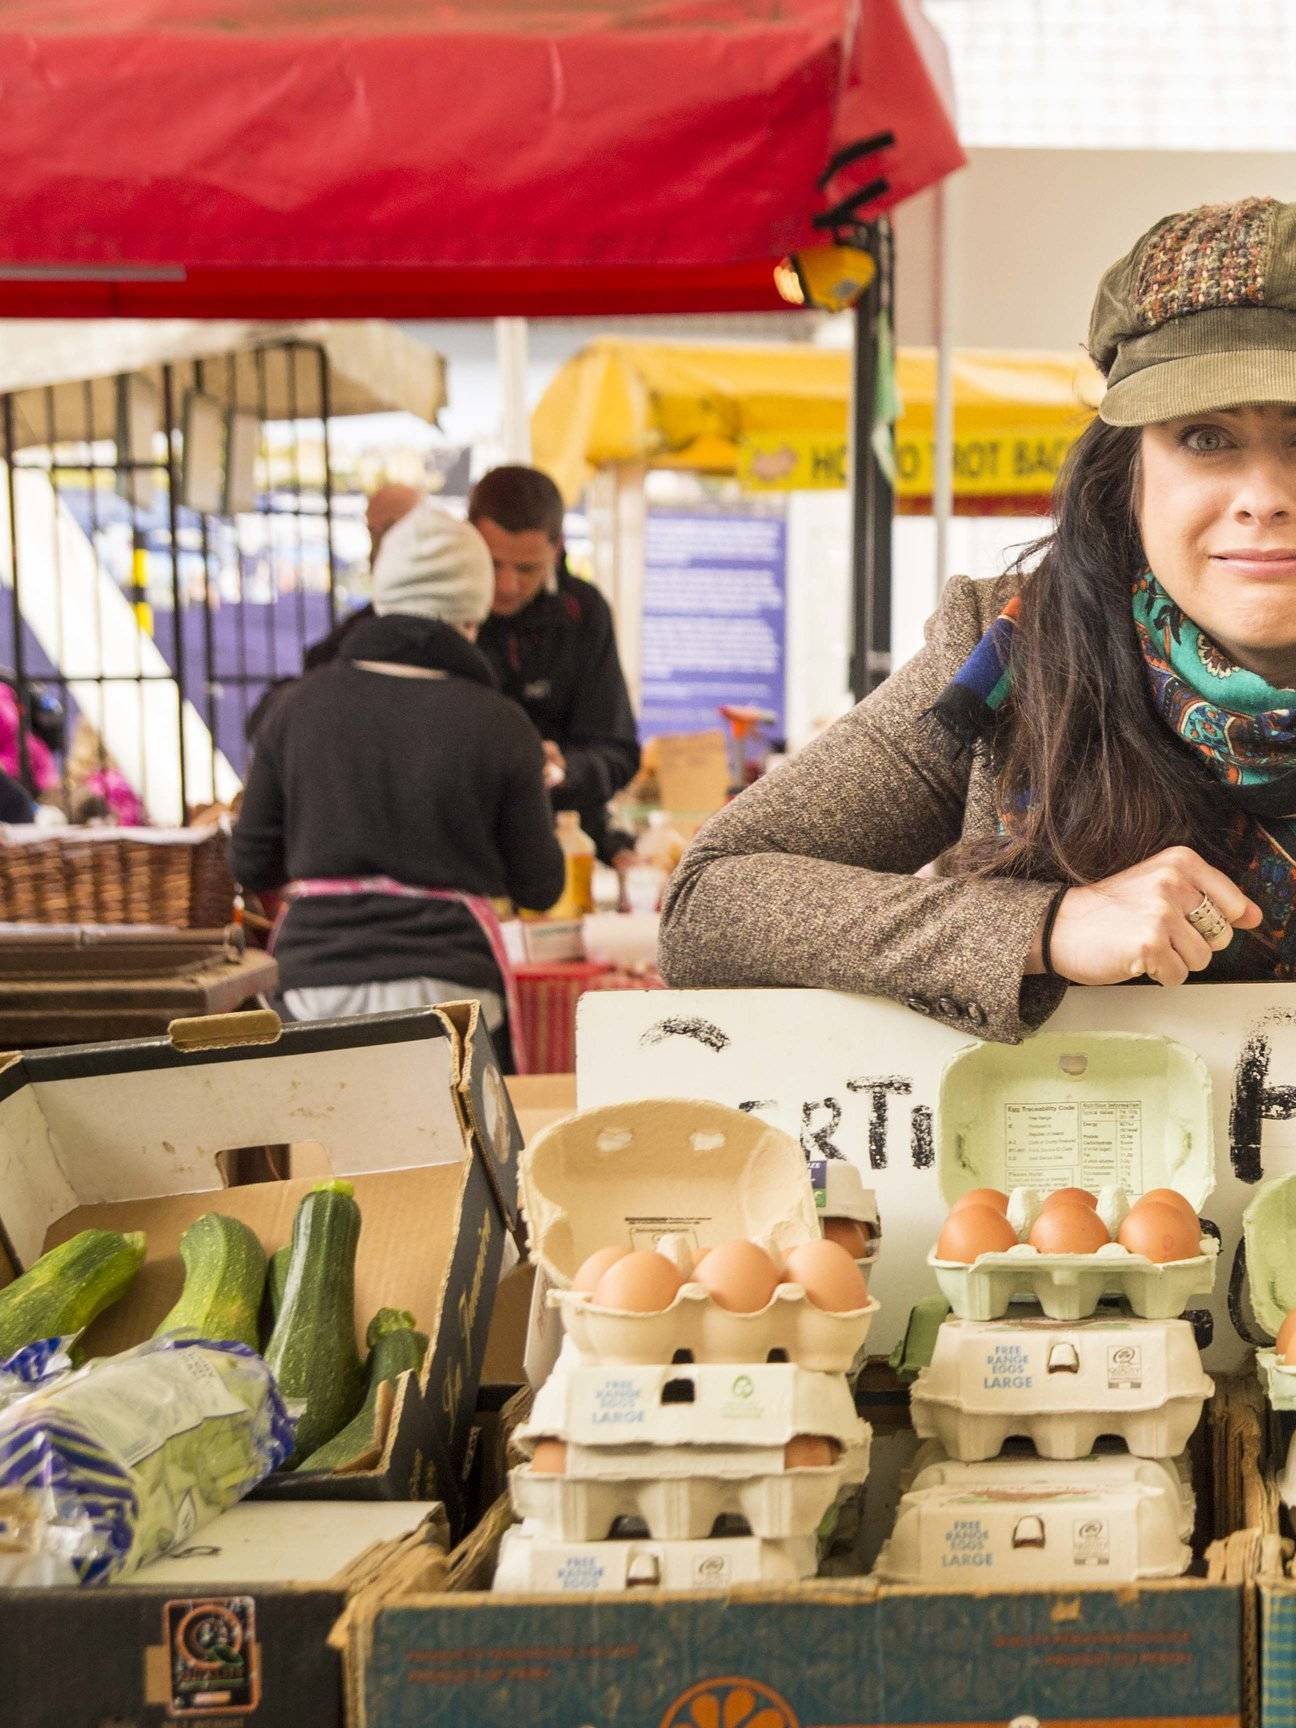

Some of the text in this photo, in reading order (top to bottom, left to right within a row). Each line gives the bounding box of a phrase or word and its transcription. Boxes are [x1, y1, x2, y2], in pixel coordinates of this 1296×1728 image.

[995, 1346, 1021, 1354] FREE
[988, 1354, 1029, 1364] RANGE
[992, 1364, 1024, 1374] EGGS
[984, 1376, 1033, 1389] LARGE
[592, 1410, 646, 1424] LARGE
[942, 1553, 993, 1567] LARGE
